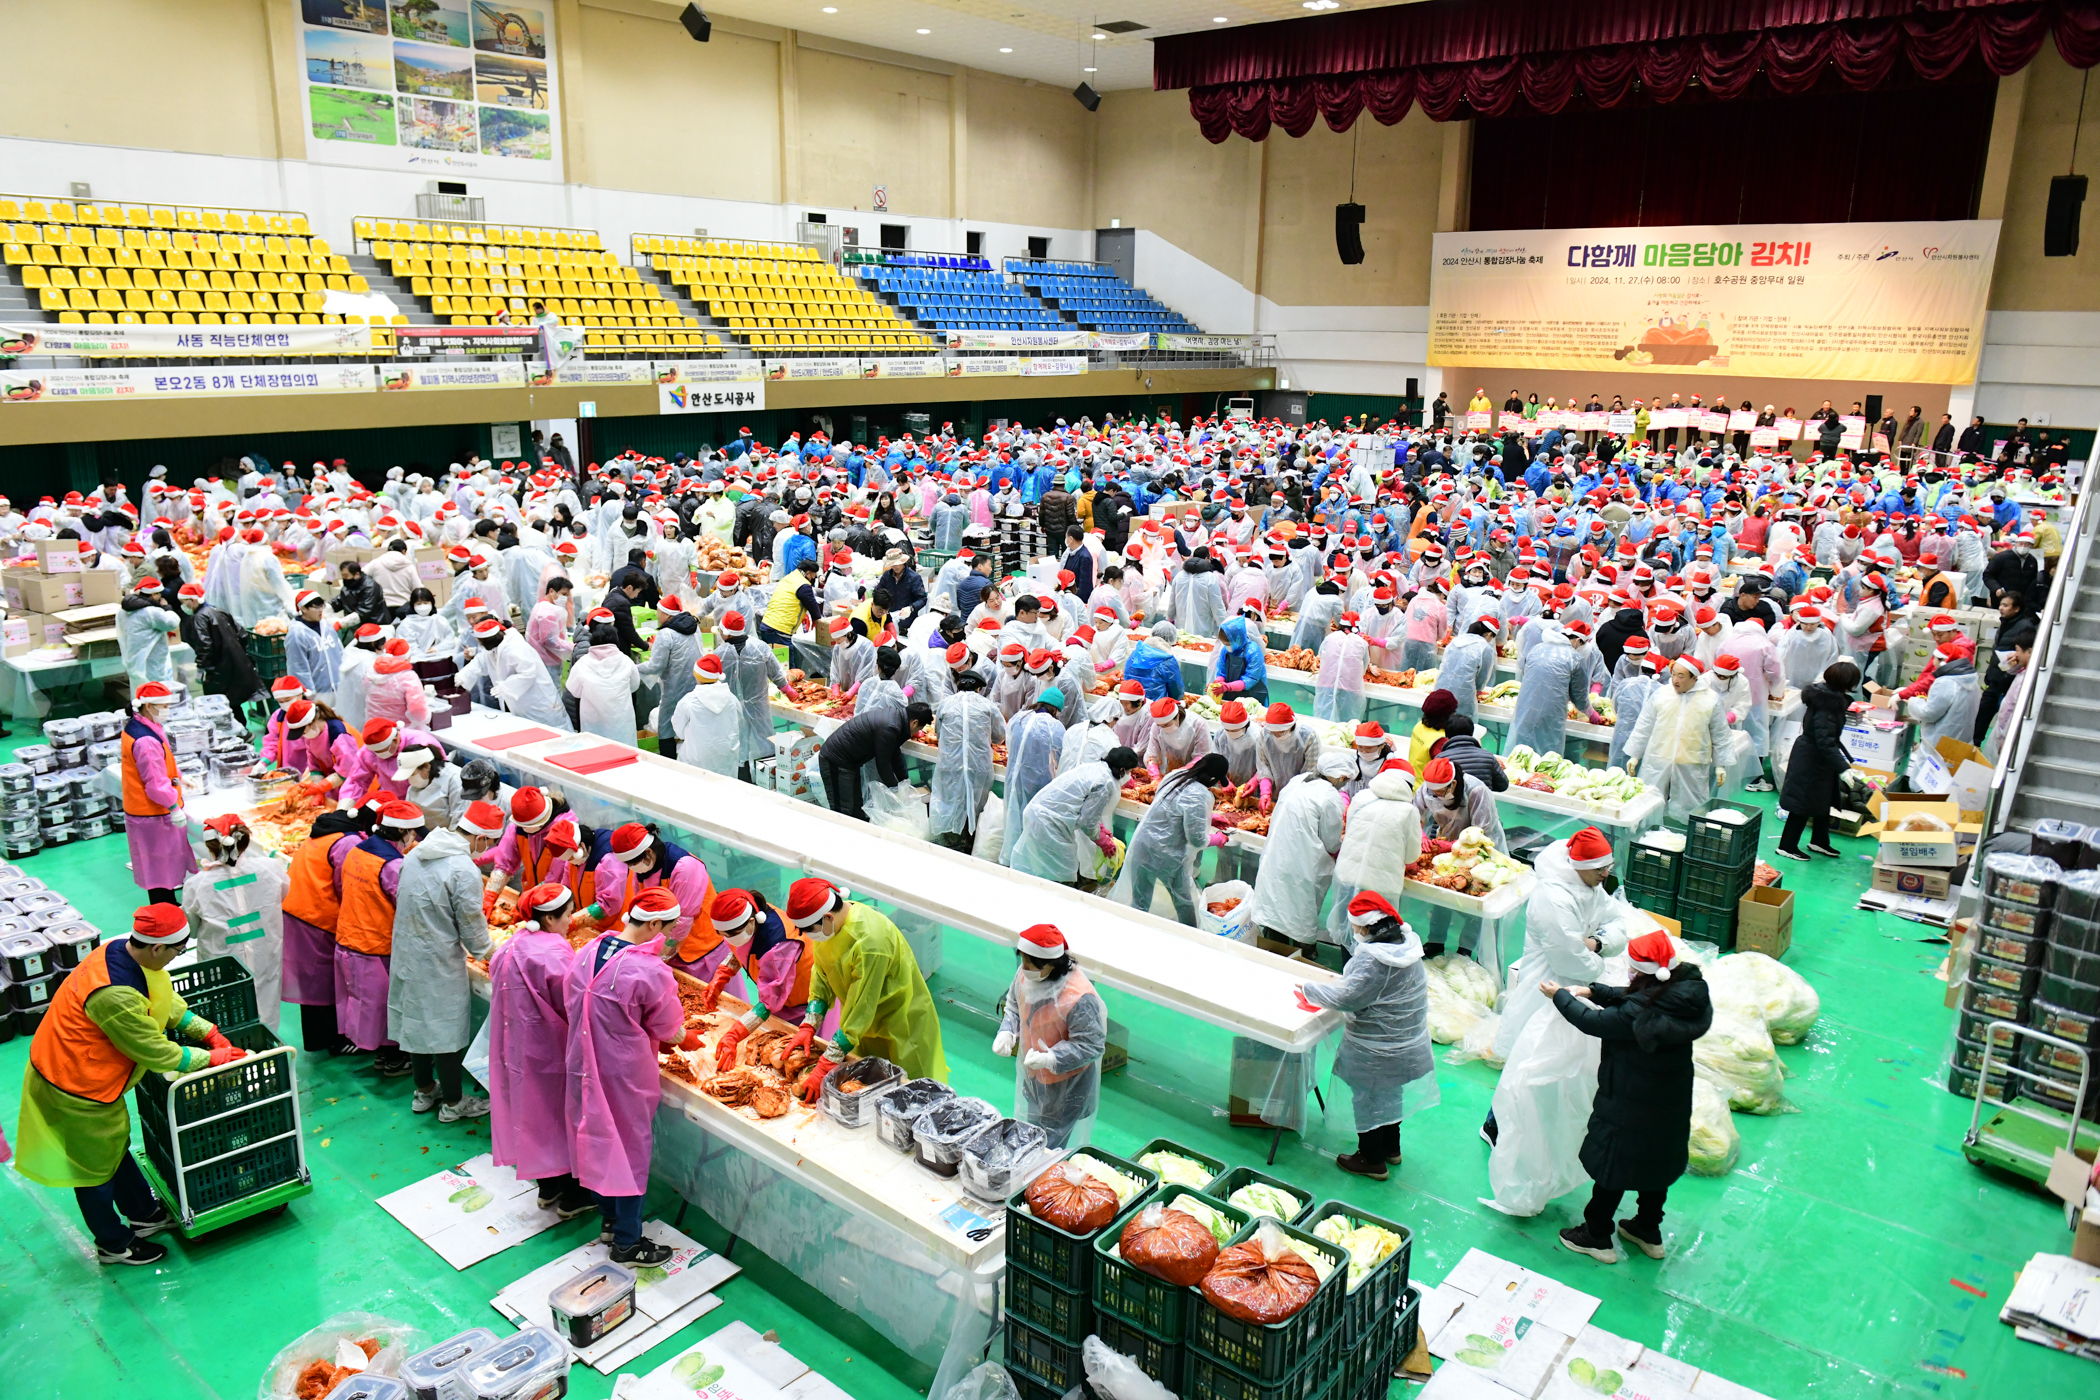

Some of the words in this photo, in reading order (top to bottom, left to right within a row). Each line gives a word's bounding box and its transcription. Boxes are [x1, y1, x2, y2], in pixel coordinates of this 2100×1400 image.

[1460, 257, 1481, 265] 안산시
[1484, 256, 1526, 265] 통합김장나눔
[1528, 256, 1544, 264] 축제
[1567, 244, 1637, 268] 다함께
[1643, 242, 1743, 267] 마음담아
[1750, 242, 1812, 267] 김치!
[1590, 276, 1611, 285] 2024.
[1614, 276, 1626, 284] 11.
[1628, 275, 1654, 285] 27.(수)
[1656, 276, 1680, 284] 08:00
[1714, 275, 1747, 285] 호수공원
[1750, 275, 1784, 285] 중앙무대
[1787, 275, 1805, 285] 일원
[177, 334, 203, 348] 사동
[209, 334, 290, 347] 직능단체연합
[473, 337, 533, 345] 지역사회보장협의체
[1011, 336, 1059, 346] 안산시자원봉사센터
[155, 376, 206, 391] 본오2동
[213, 376, 235, 388] 8개
[240, 374, 318, 387] 단체장협의회
[420, 375, 440, 385] 월피동
[442, 373, 499, 384] 지역사회보장협의체
[691, 392, 755, 407] 안산도시공사
[1851, 738, 1879, 750] 절임배추
[1900, 847, 1937, 856] 절임배추
